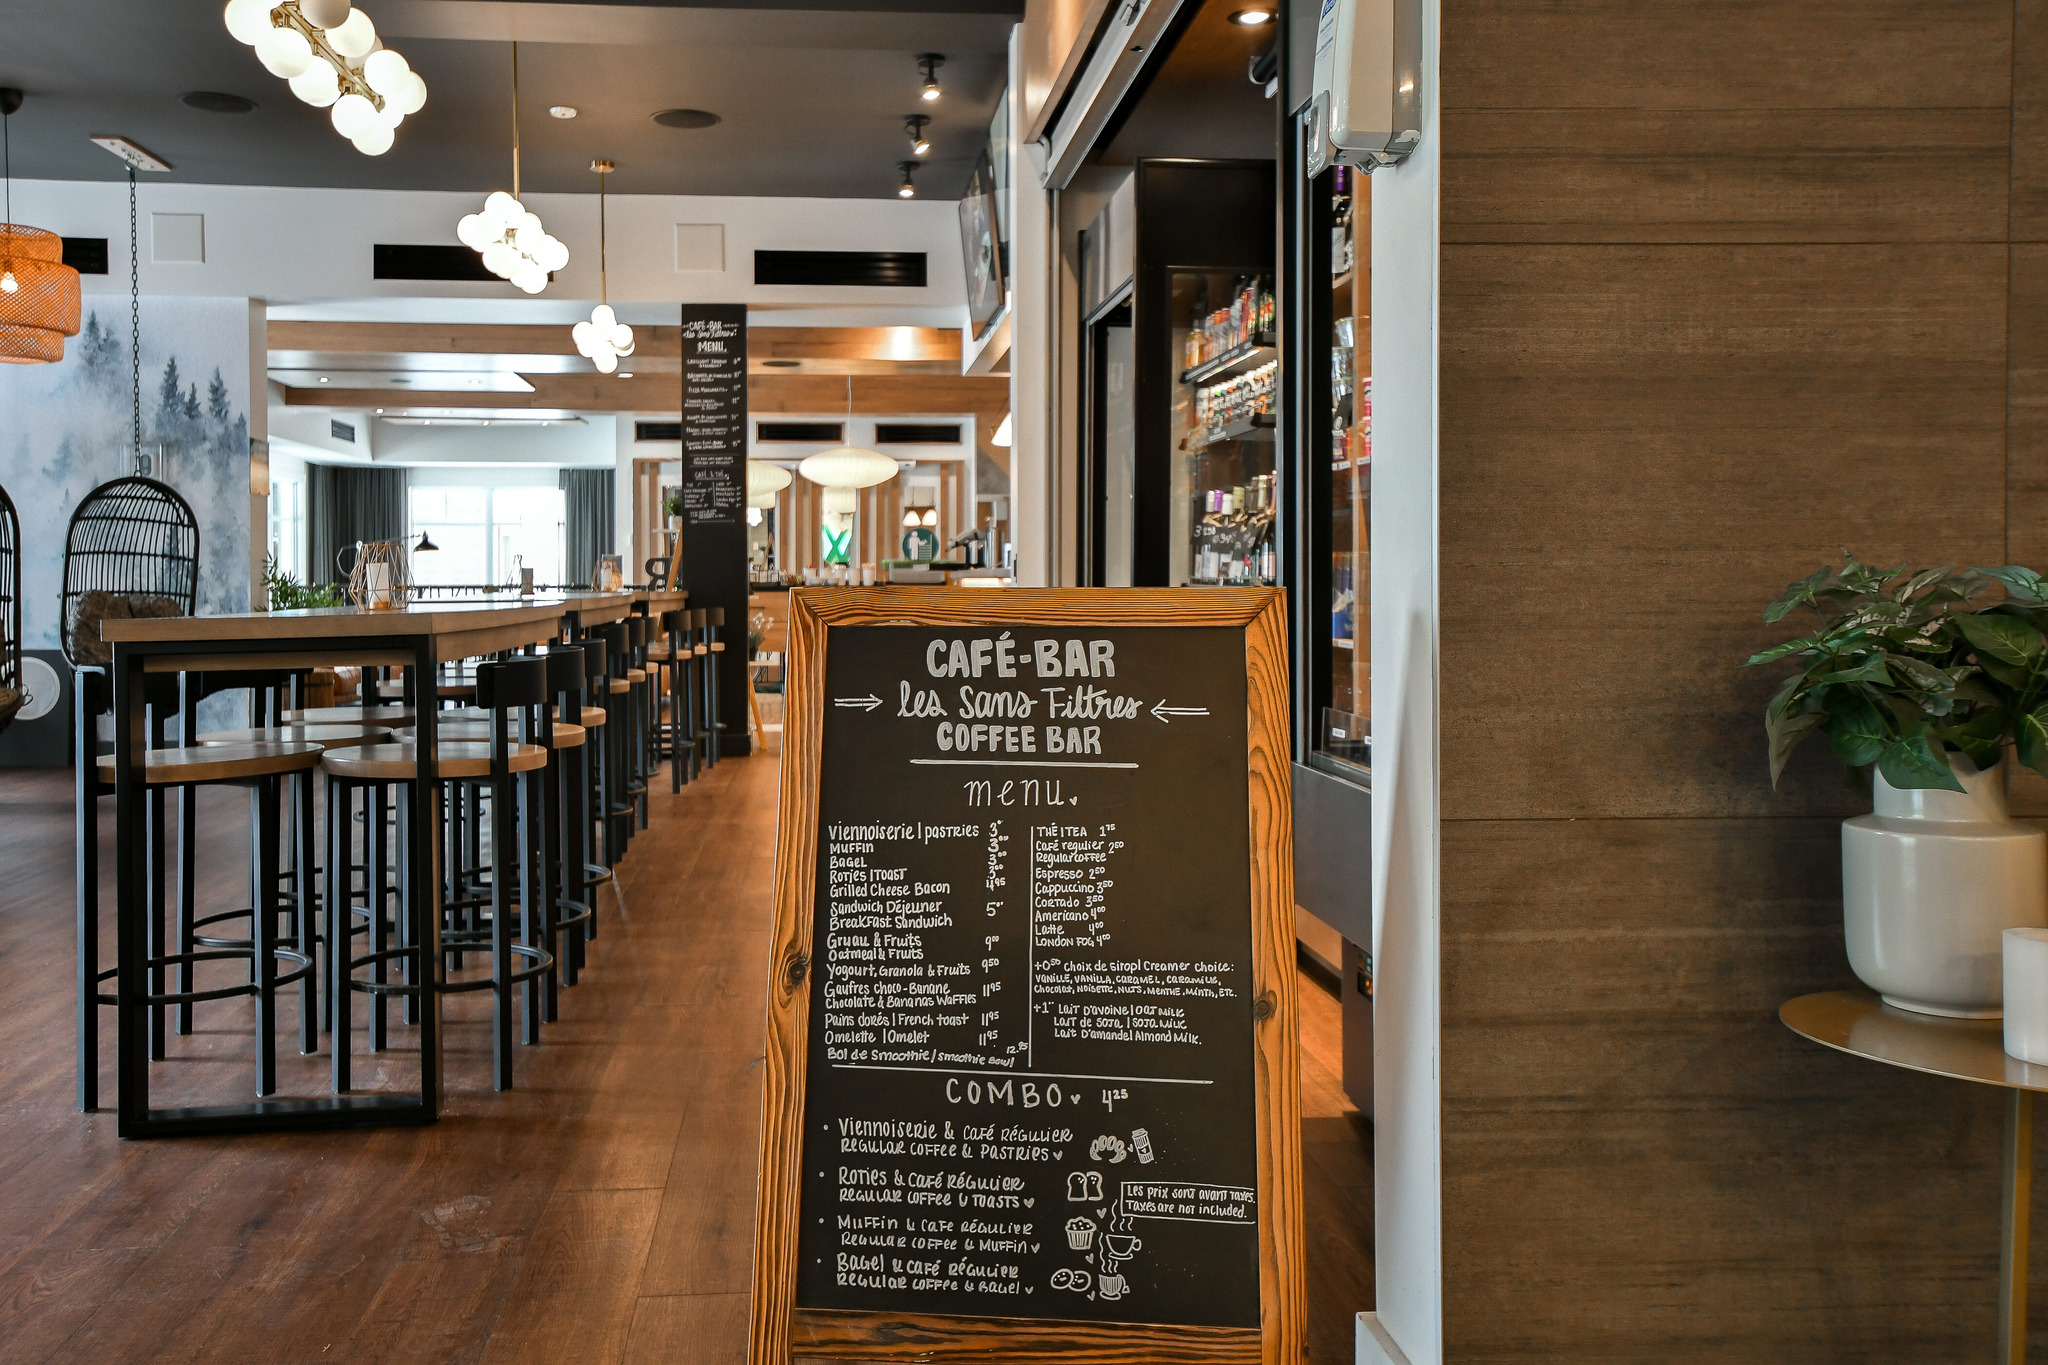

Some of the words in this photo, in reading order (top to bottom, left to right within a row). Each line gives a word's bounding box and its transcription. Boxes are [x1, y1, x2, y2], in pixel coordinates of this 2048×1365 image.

[926, 631, 1115, 678] CAFÉ-BAR
[897, 680, 948, 718] les
[959, 685, 1038, 719] Sans
[1040, 684, 1143, 720] Filtres
[937, 721, 1036, 752] COFFEE
[1046, 726, 1102, 754] BAR
[963, 779, 1064, 807] menu
[828, 820, 915, 841] Viennoiserie
[1036, 822, 1058, 837] THÉ
[1064, 826, 1087, 837] TEA
[1035, 867, 1084, 884] Espresso
[830, 882, 868, 898] Grilled
[870, 883, 911, 896] Cheese
[914, 882, 950, 896] Bacon
[1035, 881, 1095, 897] Cappuccino
[830, 899, 883, 917] Sandwich
[895, 911, 952, 929] Sandwich
[1035, 910, 1089, 923] Americano
[1035, 924, 1065, 935] Latte
[827, 932, 870, 949] Gruau
[874, 931, 881, 947] &
[884, 933, 922, 948] Fruits
[1076, 937, 1094, 947] FOG
[828, 947, 877, 962] Oatmeal
[878, 948, 886, 961] &
[888, 948, 924, 960] Fruits
[879, 964, 923, 977] Granola
[927, 964, 935, 977] &
[937, 963, 971, 976] Fruits
[1094, 959, 1108, 972] de
[1143, 961, 1190, 971] Creamer
[824, 980, 870, 998] Gaufres
[877, 995, 884, 1009] &
[886, 995, 935, 1008] Bananas
[825, 1013, 855, 1029] Pains
[898, 1013, 934, 1026] French
[936, 1013, 969, 1026] toast
[1080, 1016, 1092, 1028] de
[825, 1030, 876, 1045] Omelette
[1135, 1030, 1172, 1042] Almond
[851, 1049, 868, 1060] de
[946, 1078, 1061, 1108] COMBO
[944, 1121, 955, 1140] &
[962, 1143, 973, 1158] &
[894, 1169, 906, 1186] &
[1127, 1185, 1143, 1196] Les
[1147, 1186, 1168, 1200] prix
[1125, 1200, 1156, 1212] Taxes
[1157, 1203, 1174, 1213] are
[1199, 1203, 1247, 1218] included.
[965, 1238, 975, 1250] &
[892, 1258, 903, 1273] &
[964, 1280, 974, 1292] &
